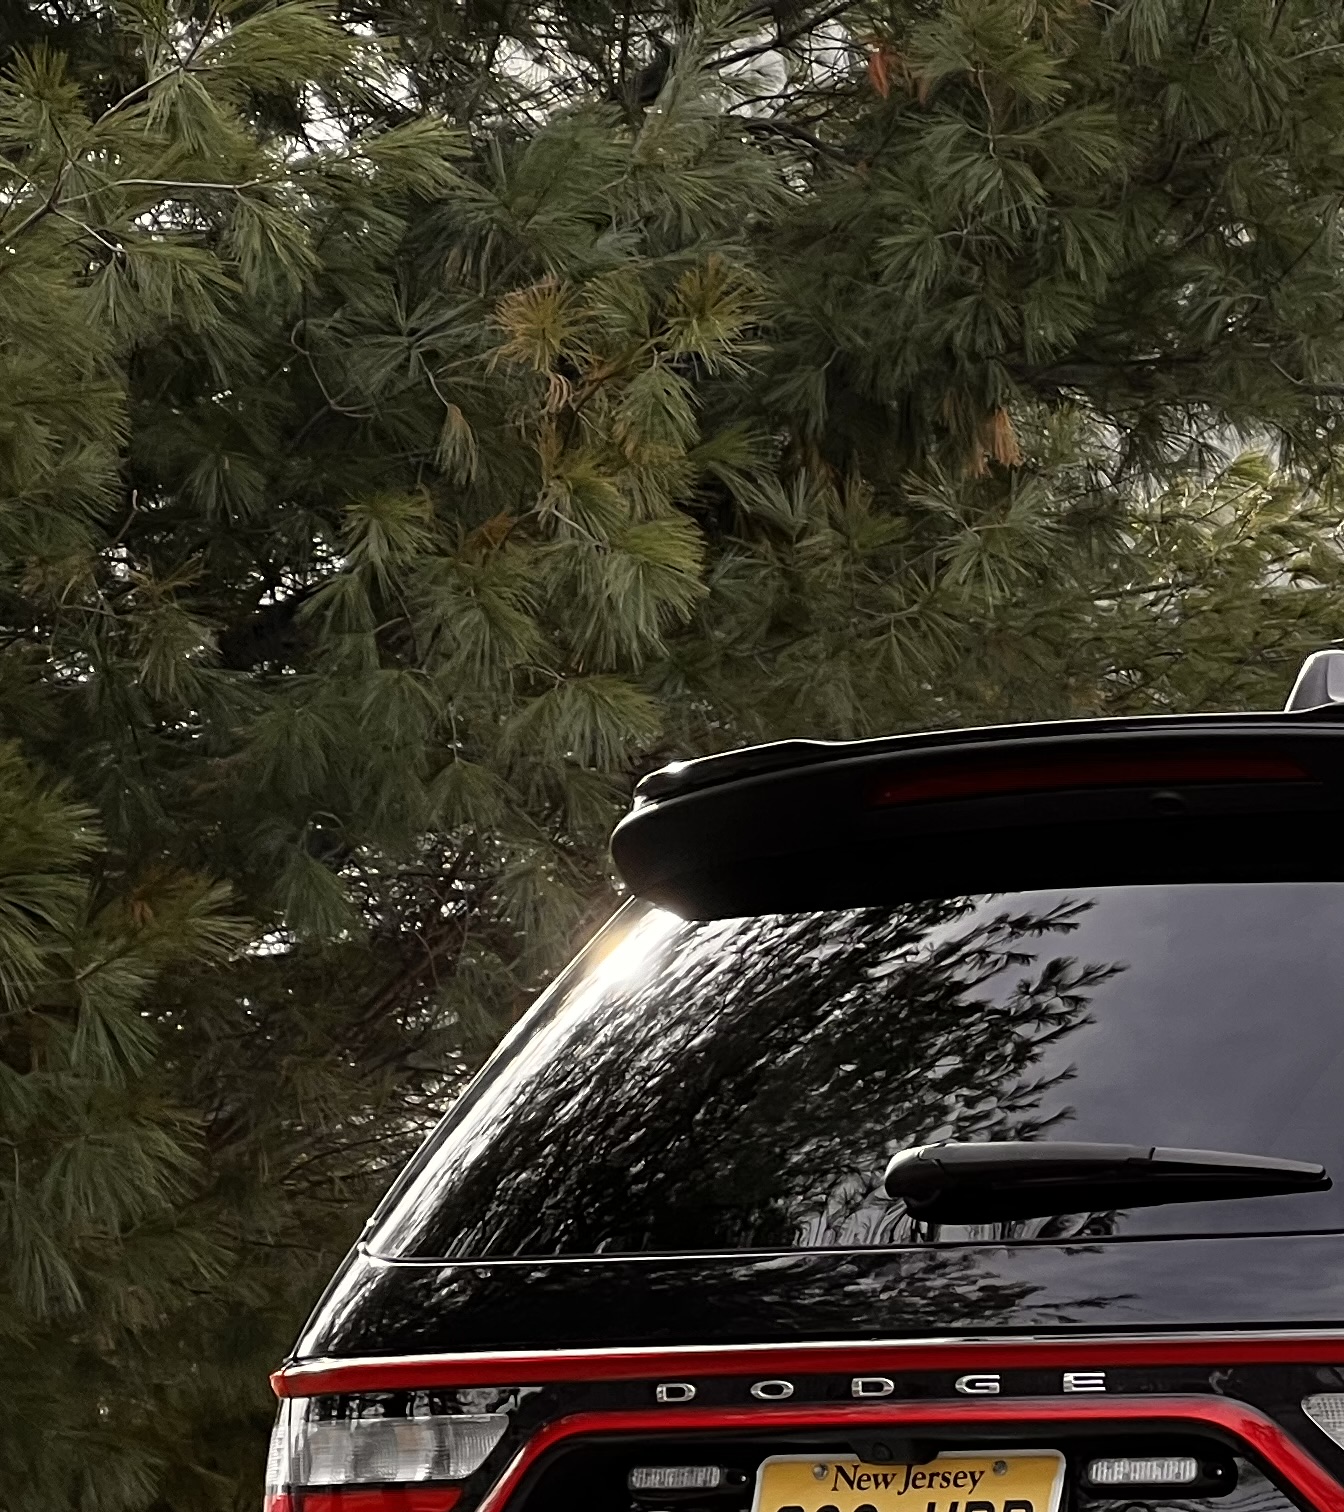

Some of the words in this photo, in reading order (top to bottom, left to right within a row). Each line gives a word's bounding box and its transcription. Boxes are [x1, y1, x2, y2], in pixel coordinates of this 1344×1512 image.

[656, 1371, 1107, 1402] DODGE
[831, 1464, 896, 1491] New
[897, 1463, 985, 1496] Jersey
